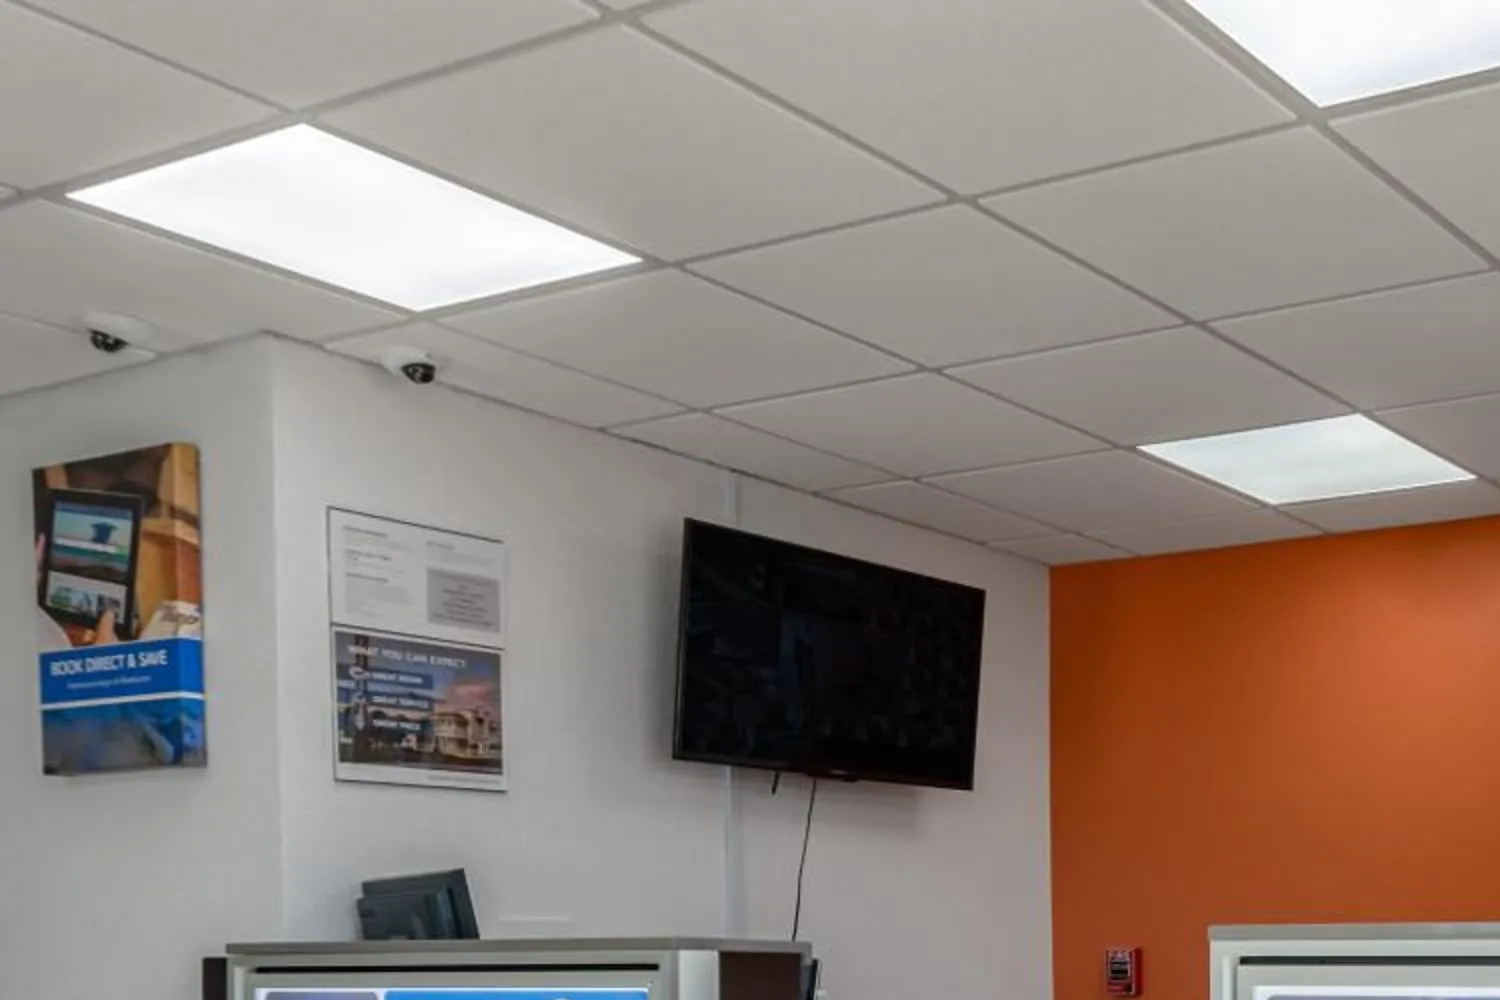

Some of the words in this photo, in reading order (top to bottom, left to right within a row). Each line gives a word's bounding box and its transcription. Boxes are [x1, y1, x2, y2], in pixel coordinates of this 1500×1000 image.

[50, 660, 83, 676] BOOK
[85, 654, 125, 672] DIRECT
[127, 653, 137, 669] &
[138, 649, 168, 667] SAVE
[381, 647, 403, 660] YOU
